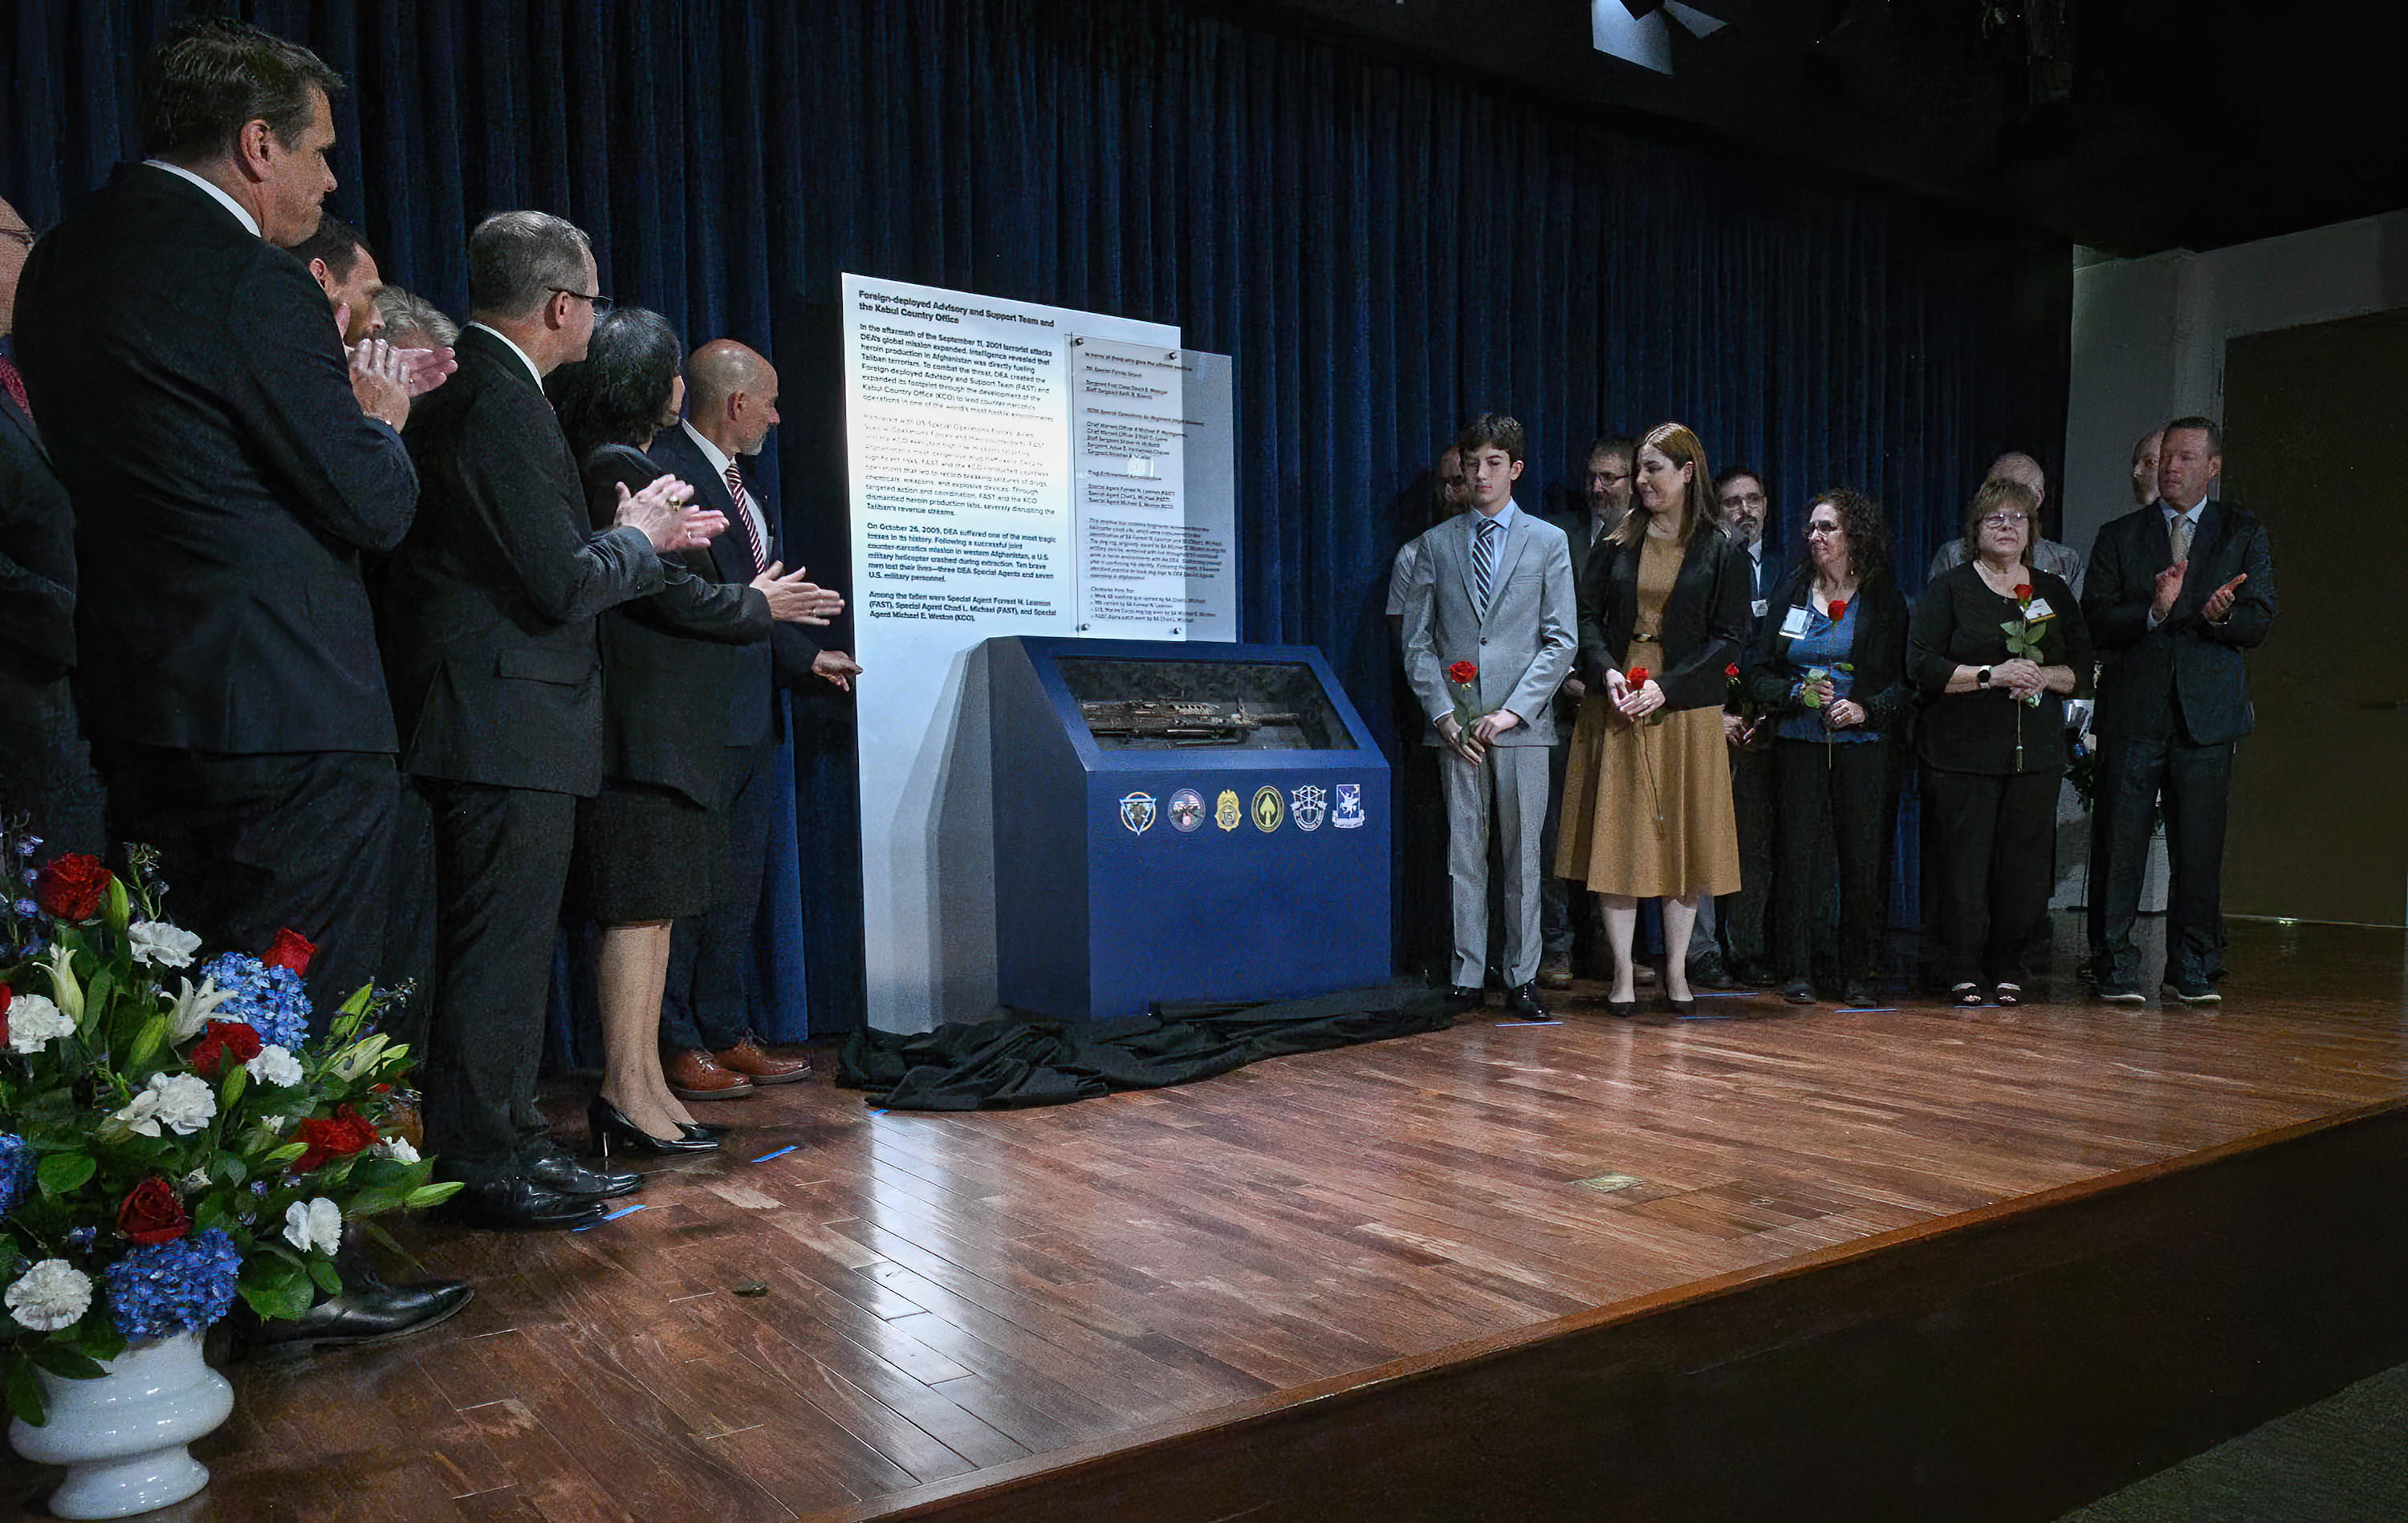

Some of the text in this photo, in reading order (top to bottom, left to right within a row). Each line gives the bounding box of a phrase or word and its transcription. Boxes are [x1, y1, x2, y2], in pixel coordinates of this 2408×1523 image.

[859, 290, 931, 308] Foreign-deployed
[933, 302, 968, 315] Advisory
[969, 309, 984, 317] and
[986, 310, 1016, 322] Support
[1018, 315, 1039, 325] Team
[859, 302, 959, 323] the Kabul Country Office
[881, 327, 916, 337] aftermath
[938, 334, 975, 345] September
[986, 341, 1002, 349] 2001
[1003, 343, 1028, 353] terrorist
[1030, 348, 1052, 356] attacks
[880, 523, 907, 531] October
[960, 530, 986, 538] suffered
